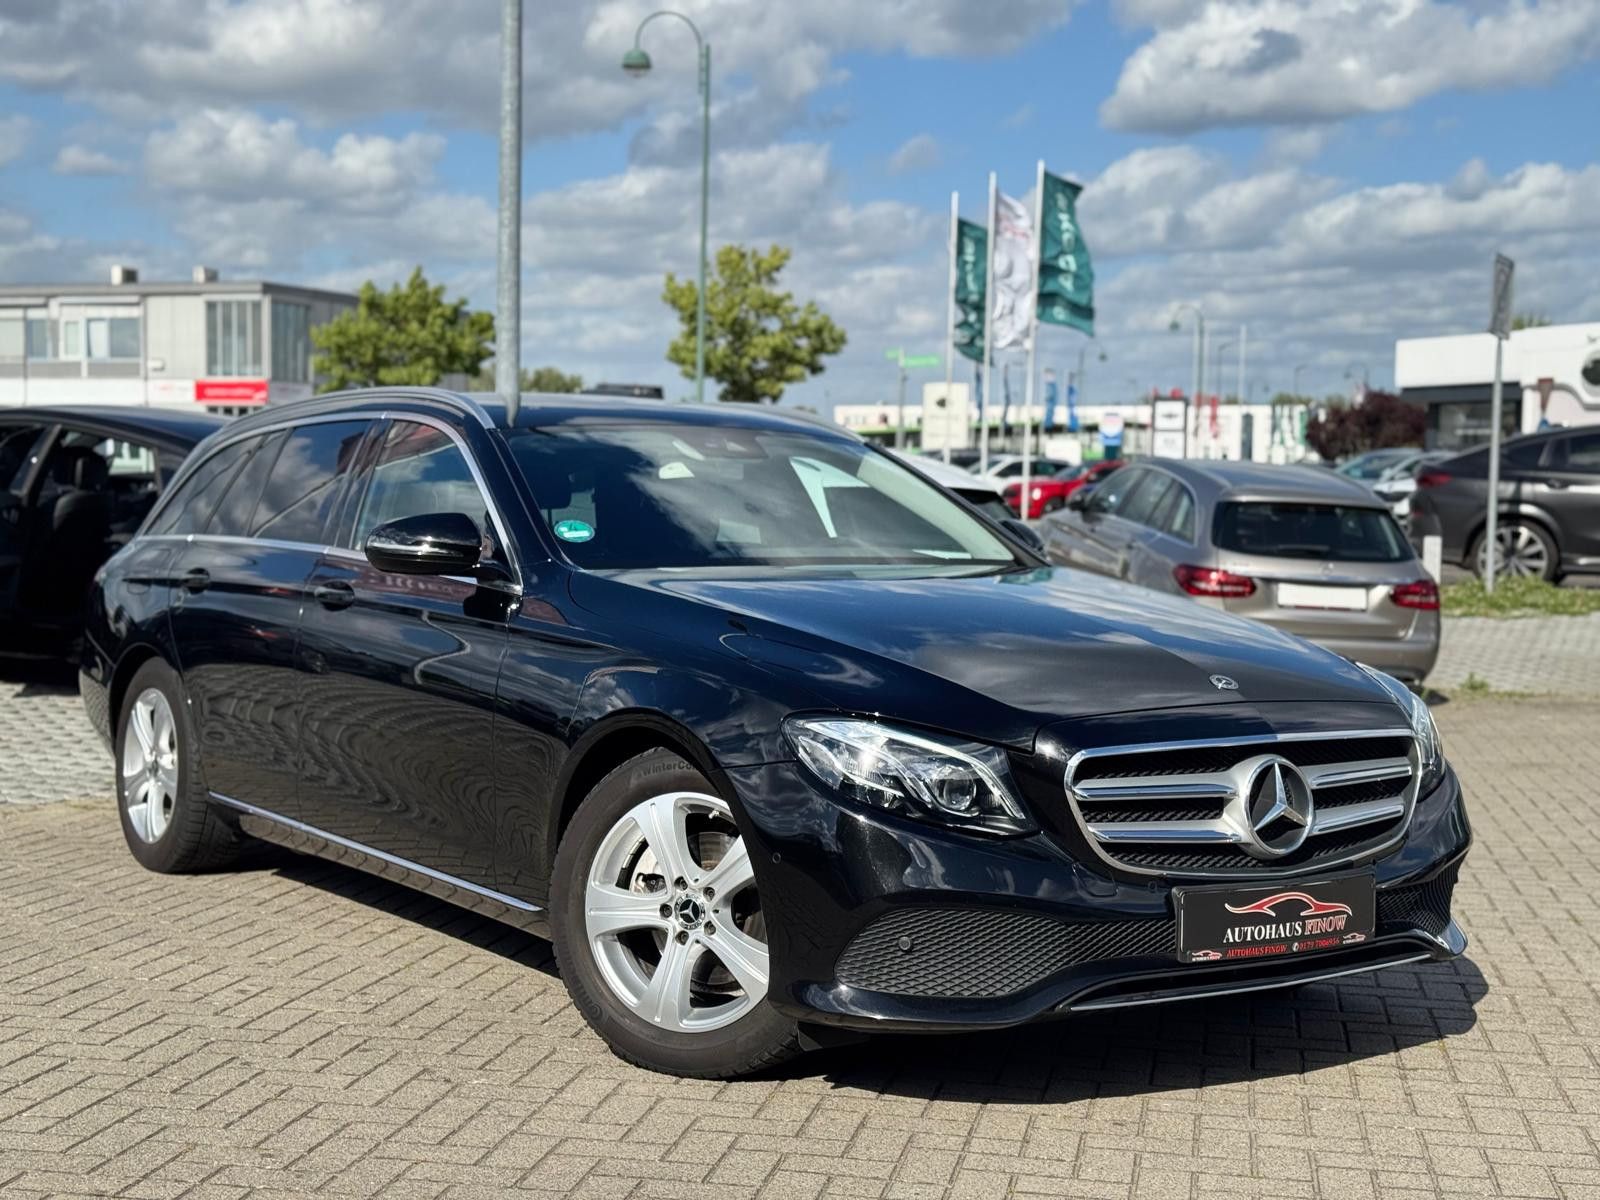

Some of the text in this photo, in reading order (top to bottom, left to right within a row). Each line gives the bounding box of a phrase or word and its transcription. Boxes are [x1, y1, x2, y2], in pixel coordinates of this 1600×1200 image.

[1223, 915, 1347, 943] AUTOHAUS FINOW
[1227, 946, 1264, 958] AUTOHAUS
